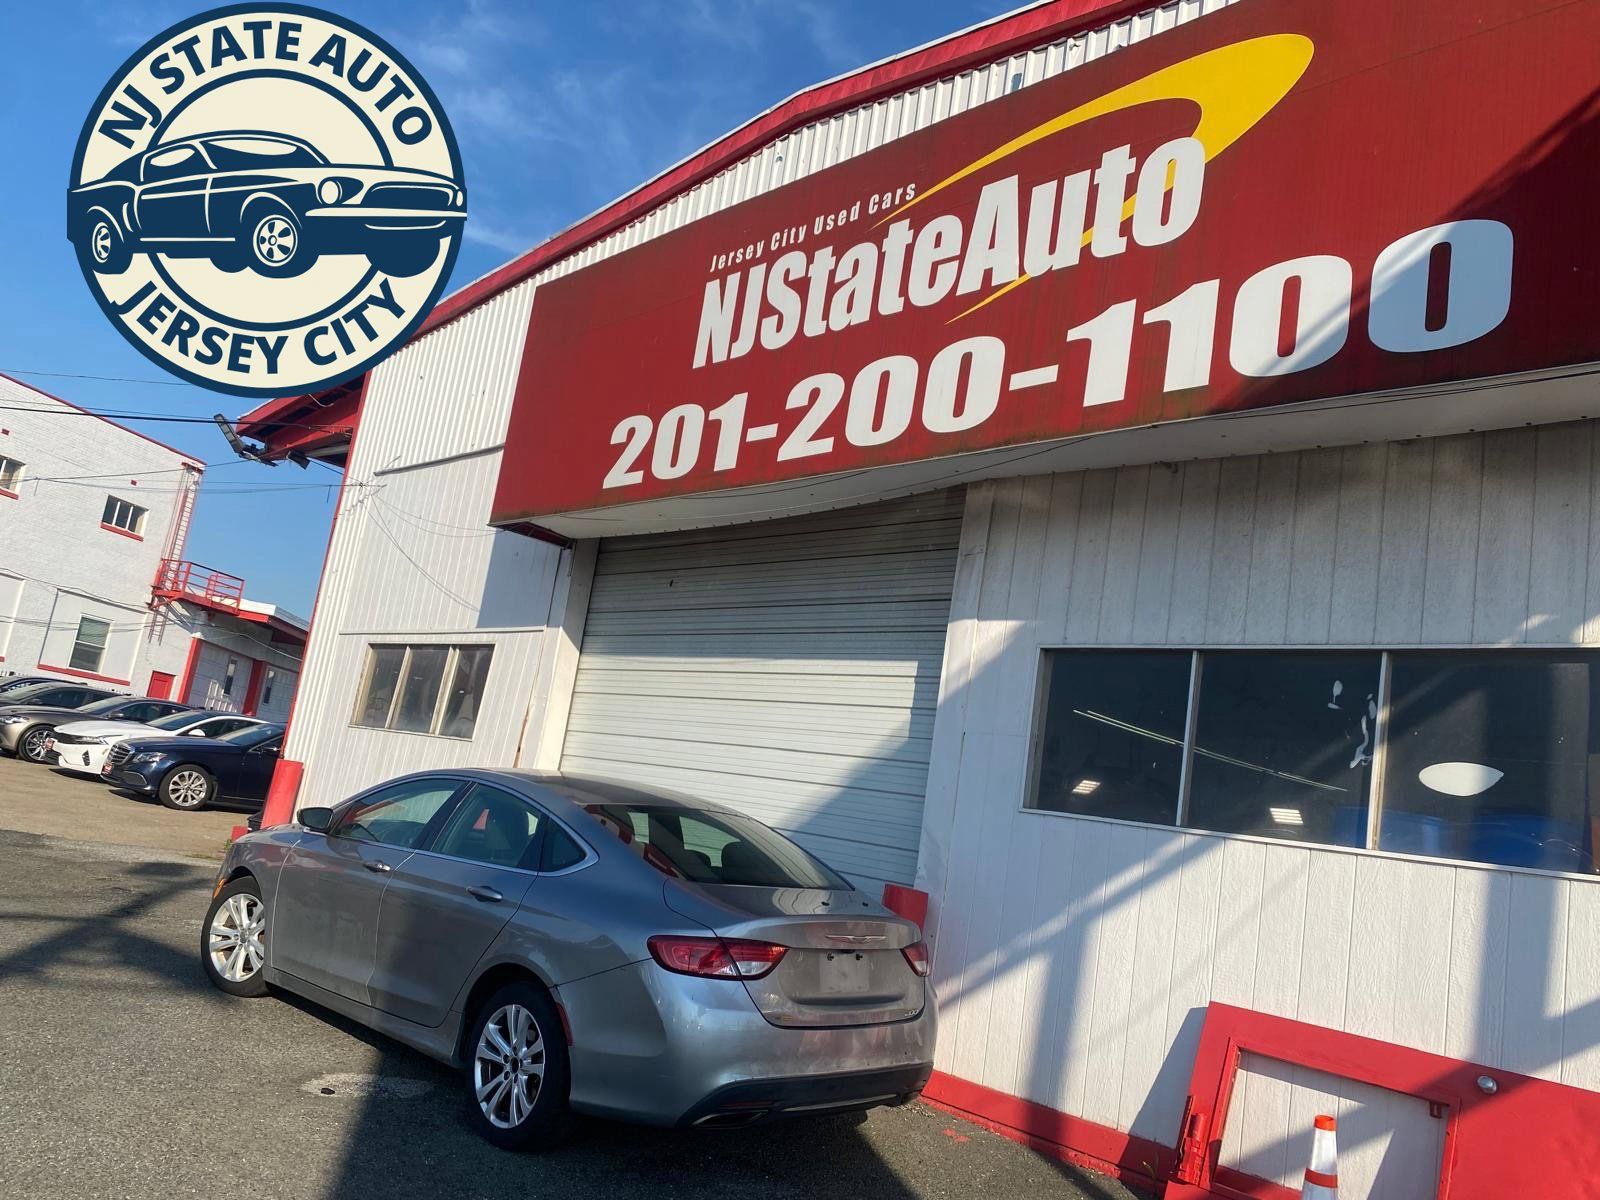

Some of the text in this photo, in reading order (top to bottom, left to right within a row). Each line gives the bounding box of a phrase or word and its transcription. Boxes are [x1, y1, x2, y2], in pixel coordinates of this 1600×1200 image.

[710, 183, 916, 272] Jersey City Used Cars
[602, 219, 1514, 489] 201-200-1100
